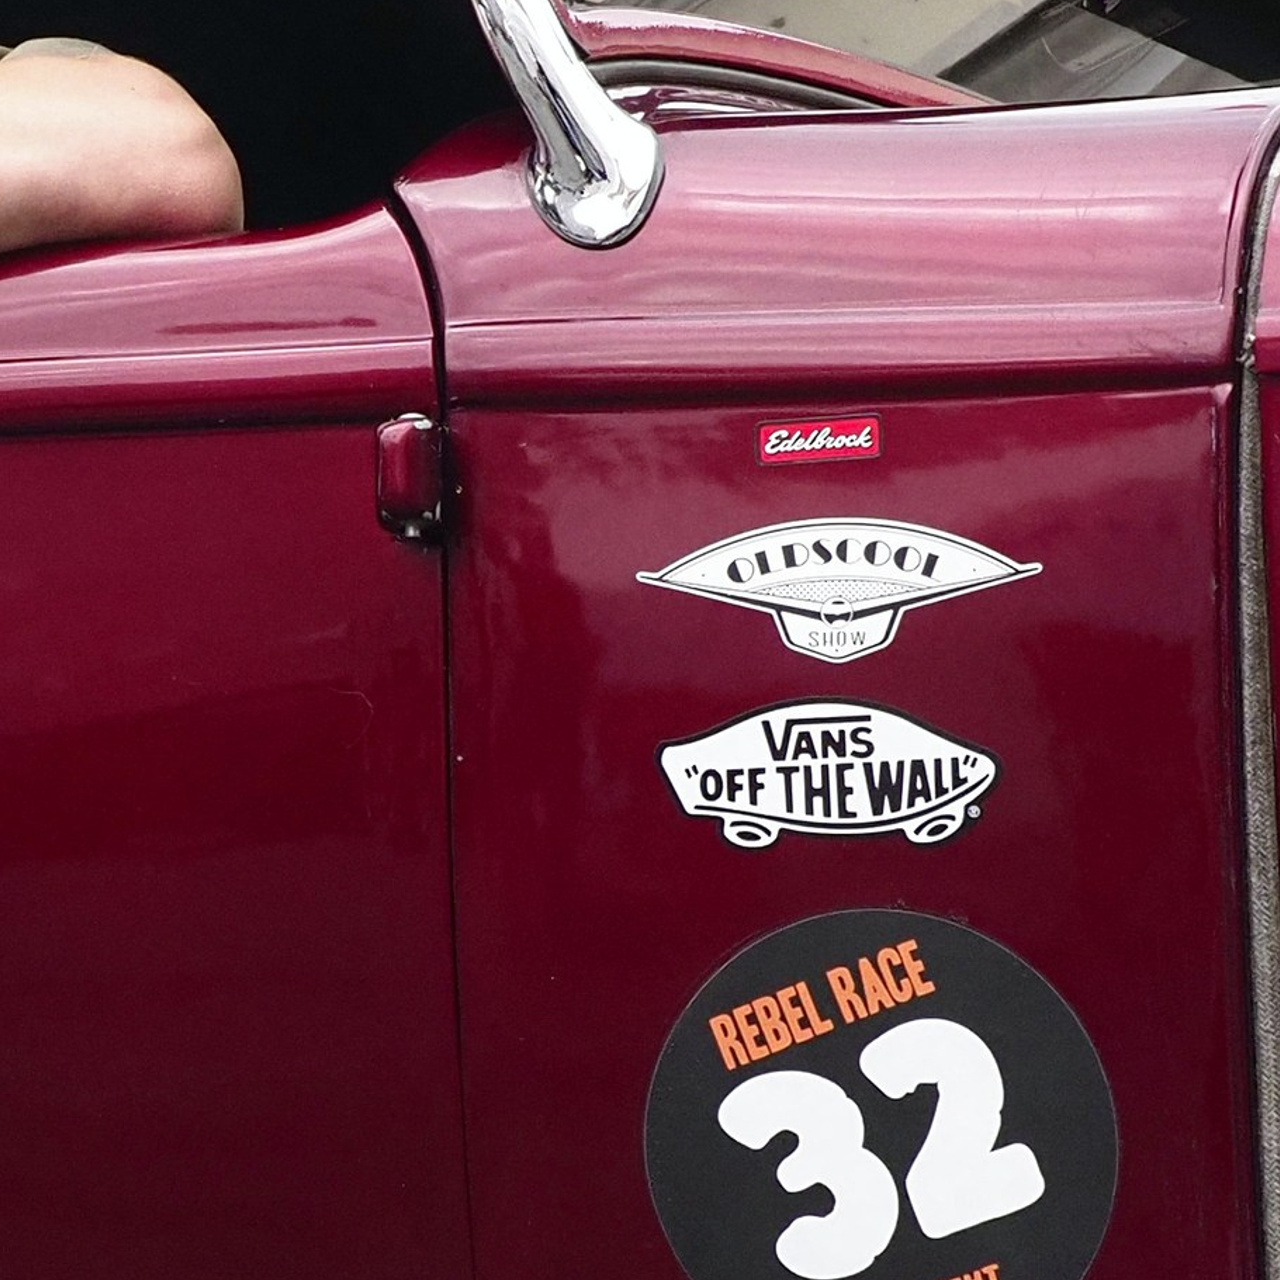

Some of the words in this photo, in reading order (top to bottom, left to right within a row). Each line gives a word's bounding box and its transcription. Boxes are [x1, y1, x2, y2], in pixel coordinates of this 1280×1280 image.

[764, 425, 873, 454] Edelbrock
[726, 538, 942, 583] OLDSCOOL
[808, 631, 866, 647] SHOW
[776, 763, 857, 818] THE
[708, 981, 834, 1071] REBEL
[826, 938, 936, 1024] RACE
[717, 1018, 1046, 1280] 32
